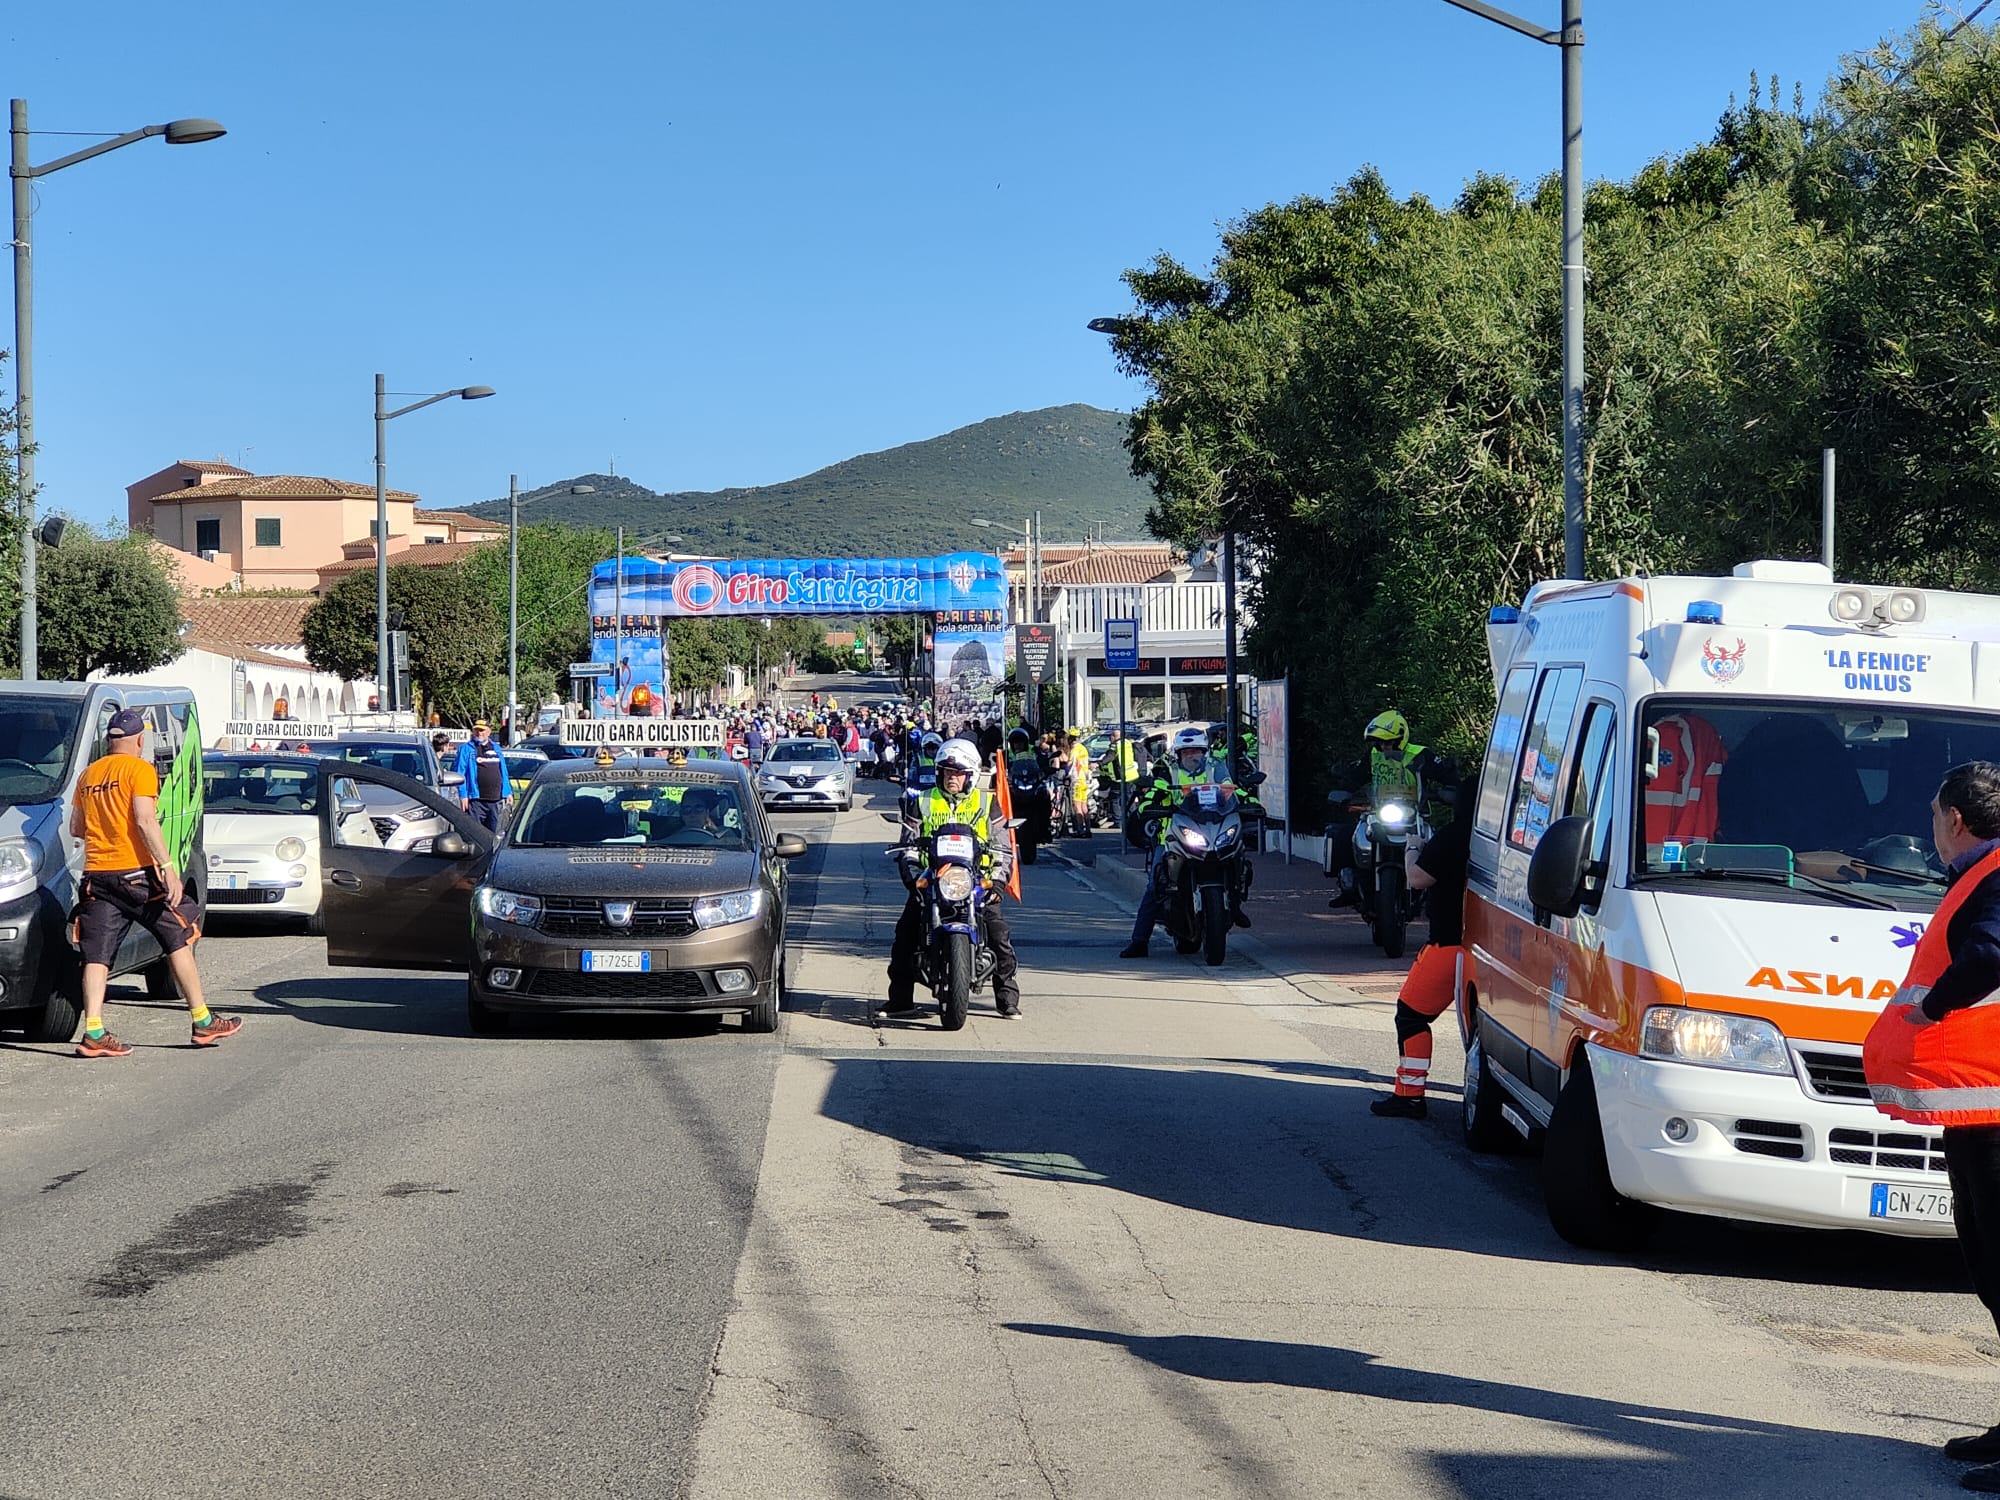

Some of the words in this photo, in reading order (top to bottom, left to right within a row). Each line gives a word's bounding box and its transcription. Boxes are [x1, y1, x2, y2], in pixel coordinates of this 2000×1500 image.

[727, 570, 922, 610] GiroSardegna
[594, 627, 630, 639] endlss
[632, 626, 660, 638] island
[936, 622, 955, 633] isola
[958, 624, 982, 632] senza
[985, 621, 1001, 632] fine
[1844, 673, 1912, 693] ONLUS
[225, 722, 253, 735] INIZIO
[255, 723, 280, 736] GARA
[282, 723, 333, 737] CICLISTICA
[567, 724, 605, 741] INIZIO
[609, 724, 644, 741] GARA
[648, 724, 720, 741] CICLISTICA
